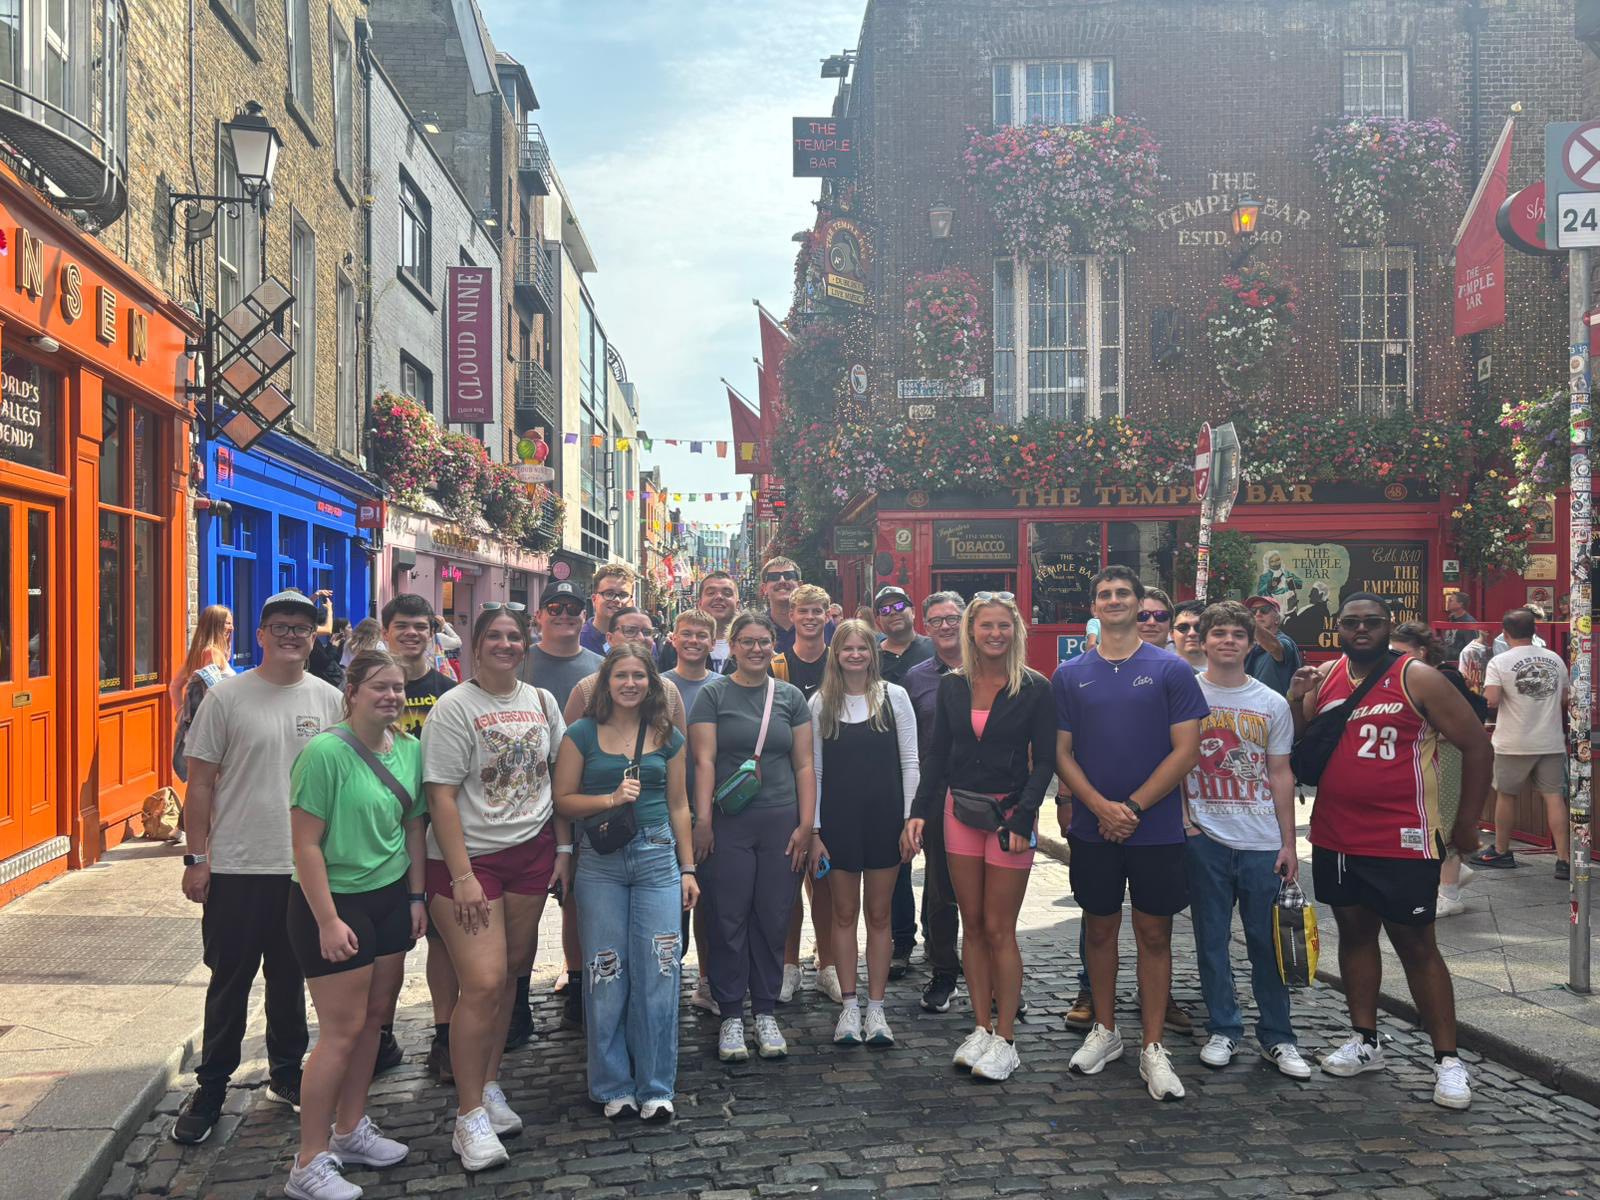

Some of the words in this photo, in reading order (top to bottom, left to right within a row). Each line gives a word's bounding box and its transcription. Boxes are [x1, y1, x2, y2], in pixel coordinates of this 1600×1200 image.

[809, 122, 837, 135] THE
[795, 139, 850, 152] TEMPLE
[810, 157, 837, 168] BAR
[1208, 172, 1259, 191] THE
[1156, 193, 1242, 230] TEMPL
[1261, 197, 1312, 230] BAR
[1562, 207, 1598, 233] 24
[16, 227, 148, 361] NSEN
[457, 273, 483, 323] NINE
[457, 331, 483, 400] CLOUD
[1, 371, 40, 403] ORLD'S
[1, 399, 42, 428] ALLEST
[1012, 488, 1081, 506] THE
[1095, 486, 1199, 506] TEMP
[1246, 484, 1314, 503] BAR
[946, 537, 1005, 558] TOBACCO
[1060, 553, 1074, 561] THE
[1304, 547, 1331, 559] THE
[1036, 563, 1076, 584] TEMPLE
[1293, 558, 1342, 569] TEMPLE
[1393, 565, 1419, 580] THE
[1304, 568, 1330, 580] BAR
[1363, 580, 1420, 594] EMPEROR
[1404, 594, 1419, 609] OF
[1348, 702, 1404, 722] ELAND
[1239, 713, 1269, 751] CITY
[1357, 723, 1398, 760] 23
